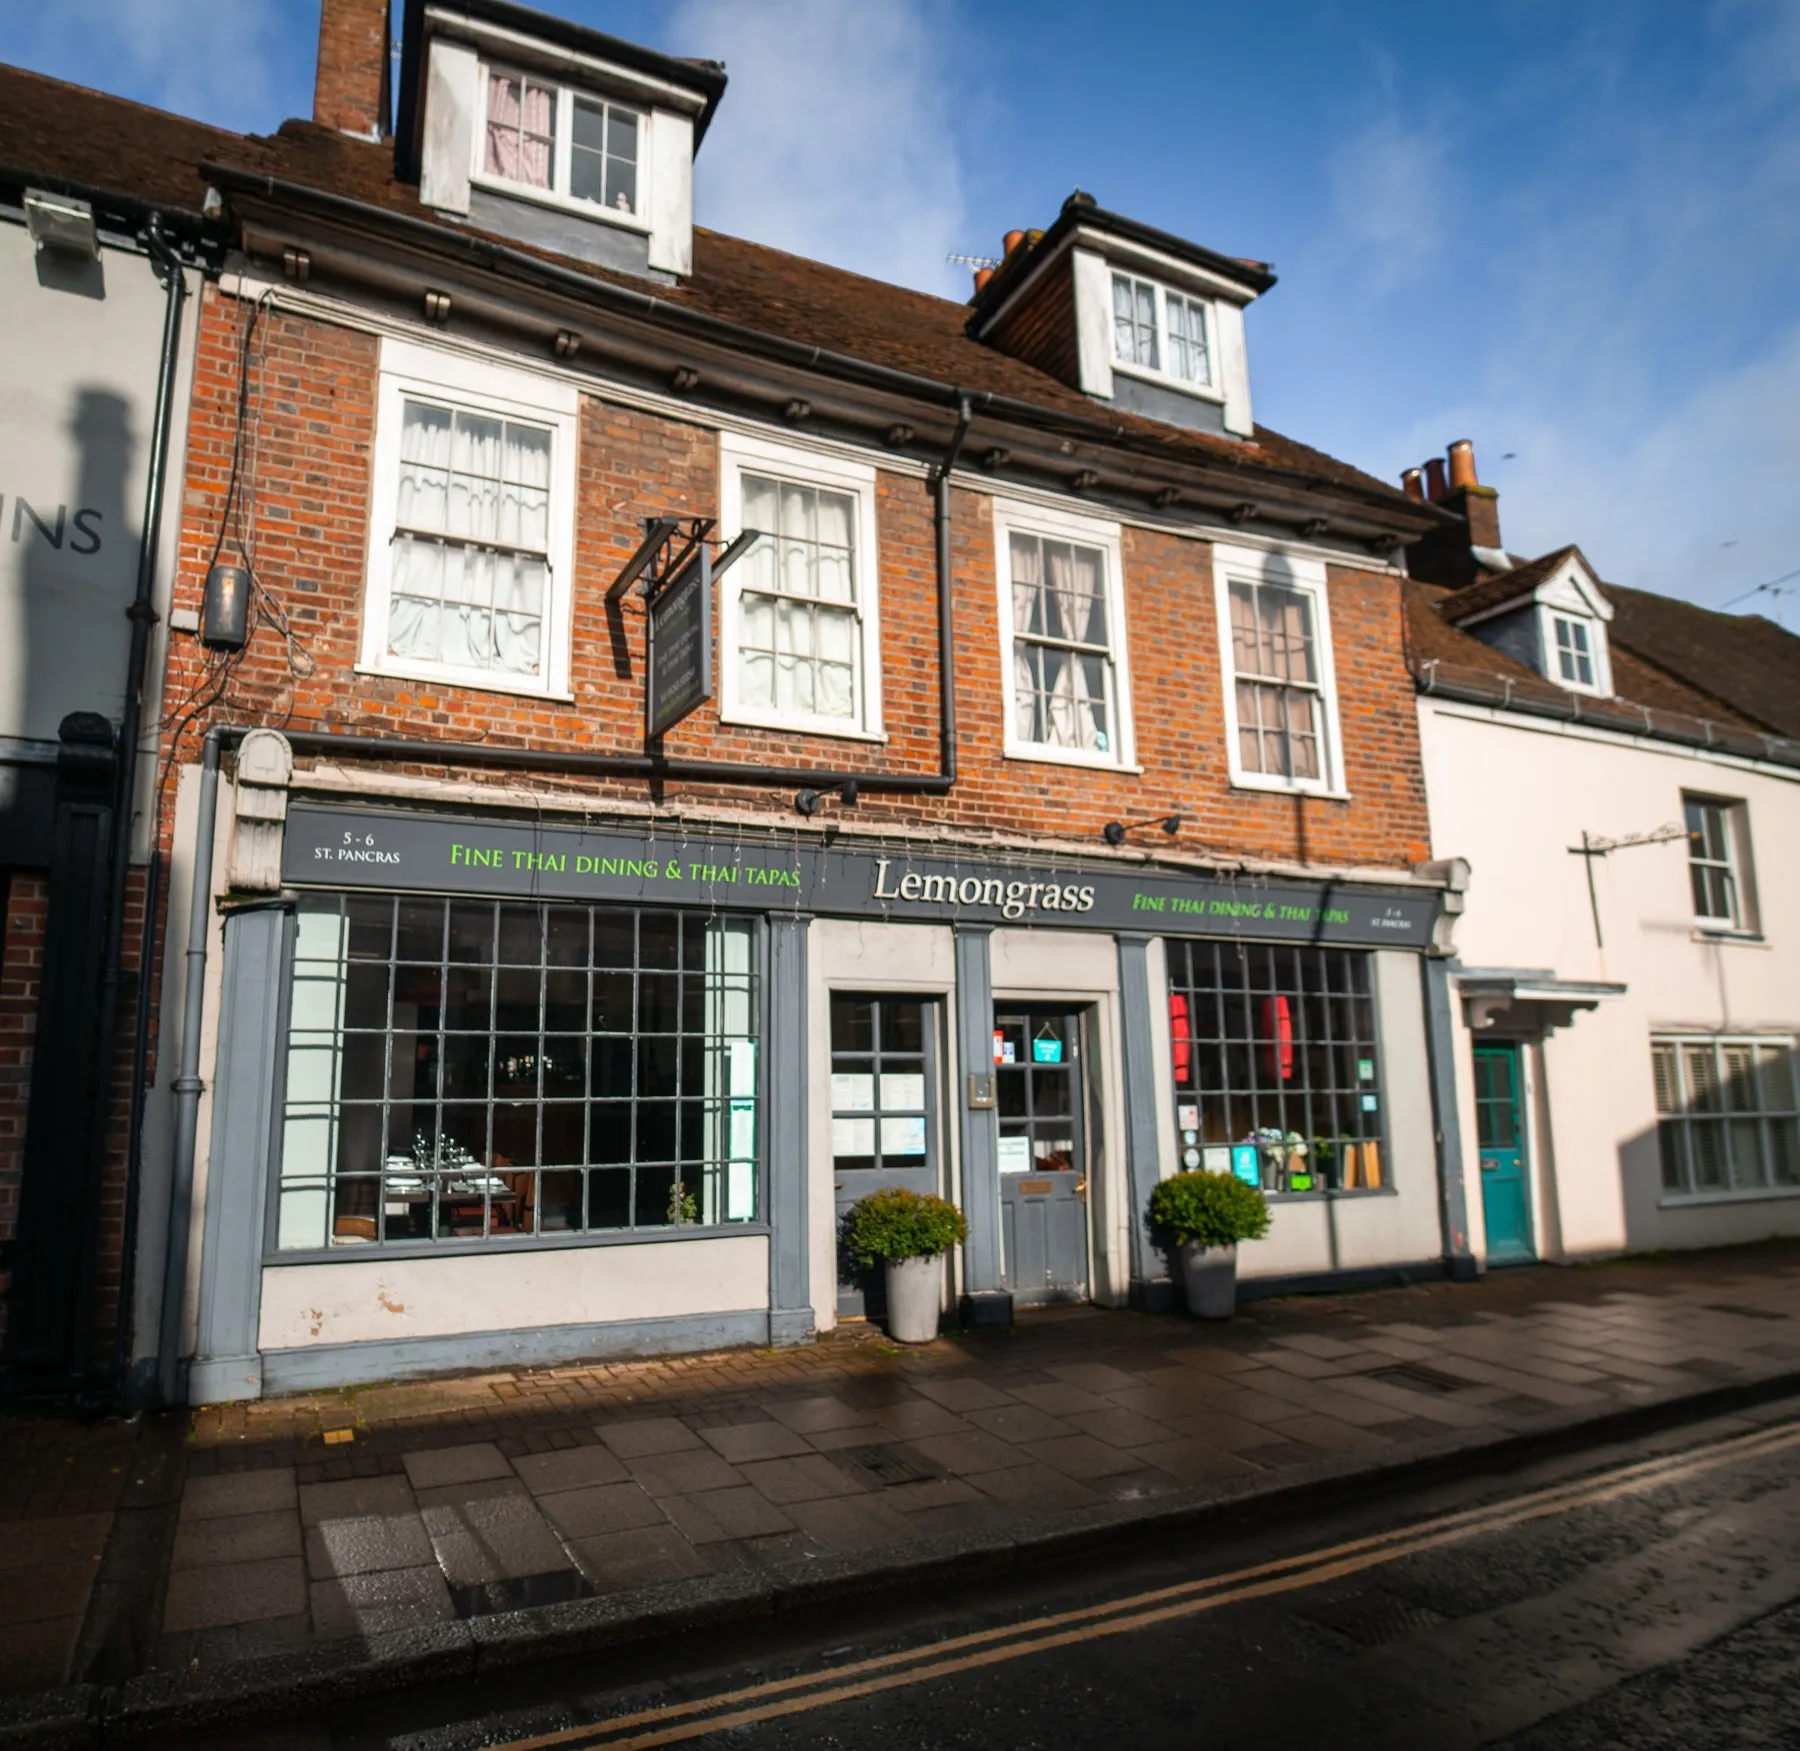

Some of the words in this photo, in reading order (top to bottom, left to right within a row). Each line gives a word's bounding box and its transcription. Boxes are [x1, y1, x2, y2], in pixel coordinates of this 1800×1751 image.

[0, 492, 103, 555] NS
[314, 847, 333, 860] ST.
[338, 848, 400, 864] PANCRAS
[343, 832, 352, 845] 5
[365, 833, 375, 847] 6
[450, 844, 504, 868] FINE
[511, 851, 566, 872] THAI
[575, 855, 658, 879] DINING
[665, 860, 682, 880] &
[689, 863, 737, 884] THAI
[745, 867, 800, 888] TAPAS
[873, 859, 1096, 920] Lemongrass
[1132, 893, 1165, 912] FINE
[1170, 897, 1205, 914] THAI
[1208, 900, 1261, 918] DINING
[1263, 903, 1275, 920] &
[1279, 905, 1311, 921] THAI
